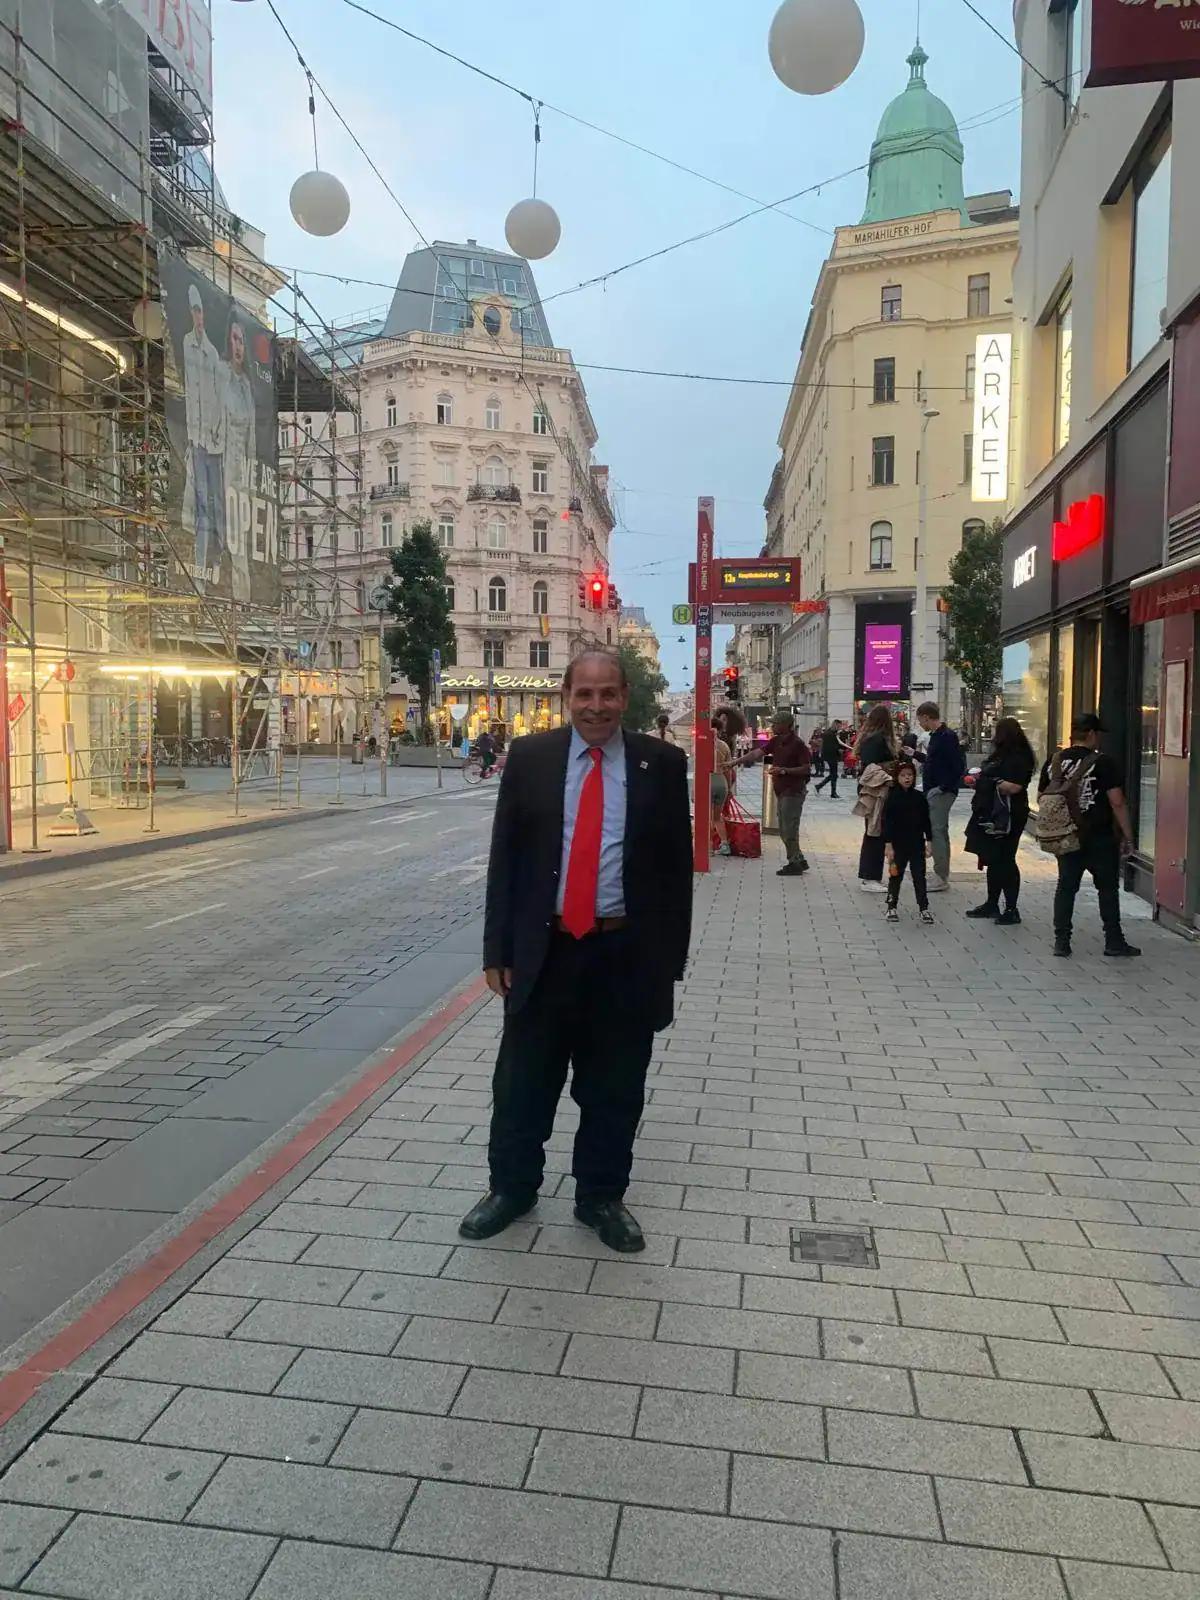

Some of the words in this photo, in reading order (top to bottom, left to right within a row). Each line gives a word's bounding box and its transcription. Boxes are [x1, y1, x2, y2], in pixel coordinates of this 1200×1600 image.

[854, 222, 932, 244] MARIAHILFER-HOF
[980, 339, 1004, 496] ARKET
[260, 463, 277, 499] ARE
[225, 486, 278, 565] OPEN
[785, 572, 791, 583] 2
[678, 610, 688, 621] H
[720, 610, 775, 619] Neubaugasse
[493, 674, 558, 688] Ritter
